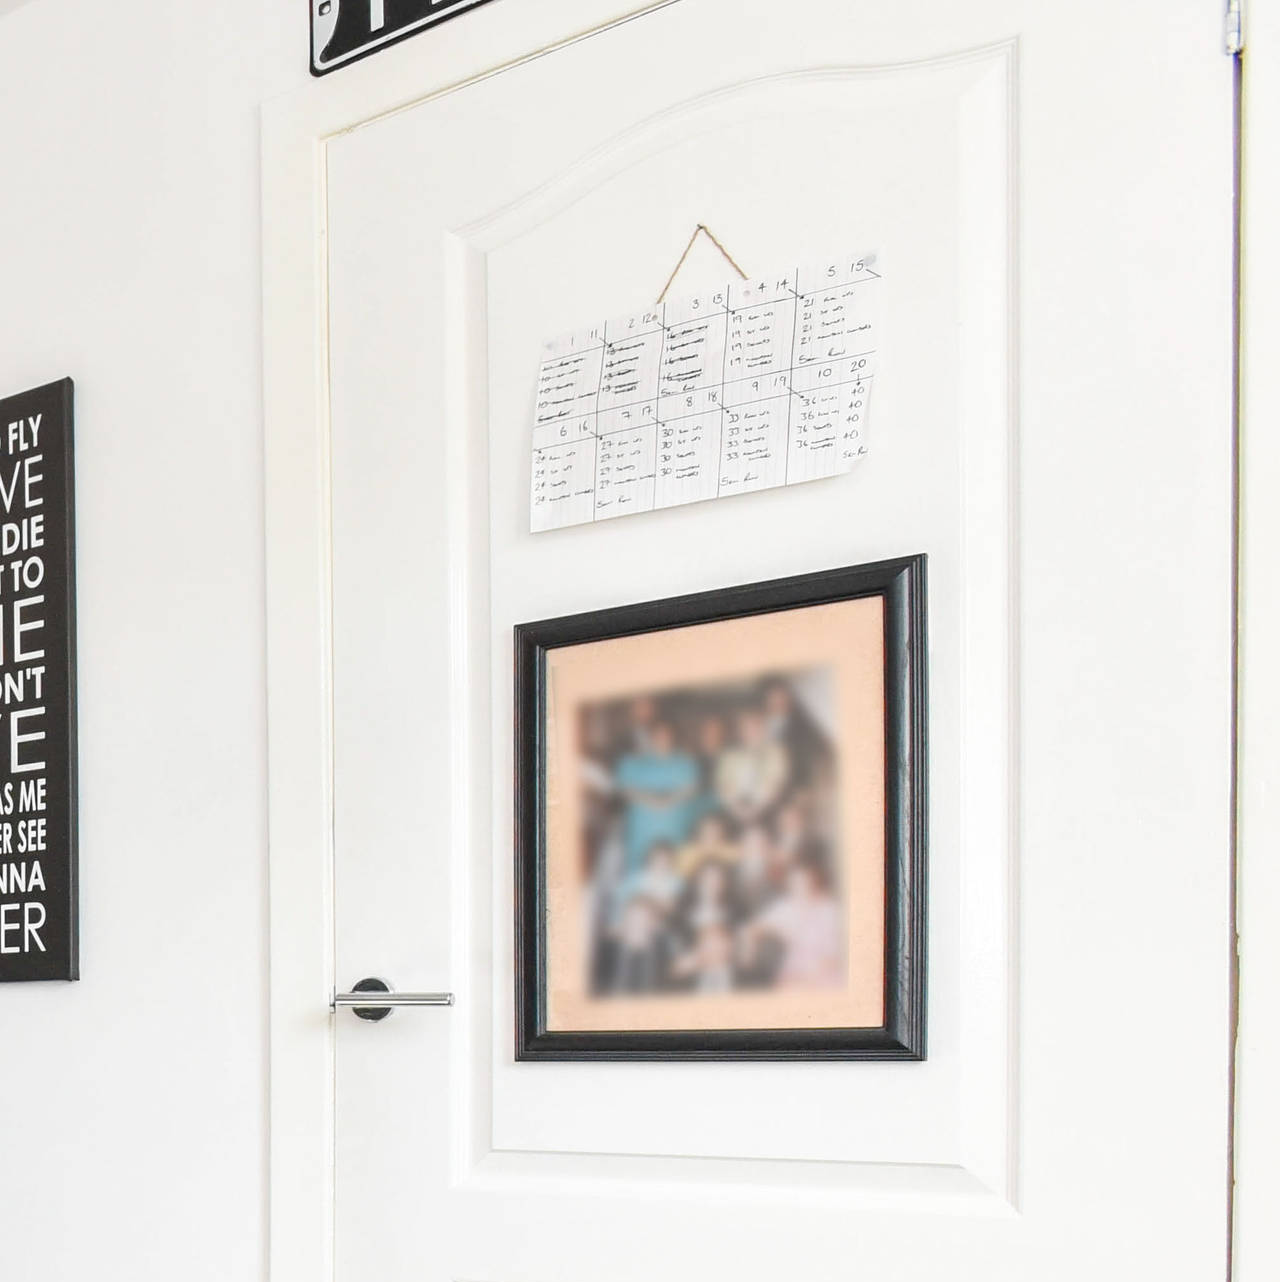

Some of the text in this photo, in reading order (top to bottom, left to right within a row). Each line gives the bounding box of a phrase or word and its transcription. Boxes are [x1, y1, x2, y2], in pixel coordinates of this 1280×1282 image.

[827, 259, 864, 277] 5 15
[758, 279, 788, 293] 4 14
[692, 299, 699, 309] 3
[818, 359, 866, 378] 10 20
[752, 376, 786, 391] 9 19
[707, 391, 717, 401] 18
[8, 413, 42, 455] FLY
[560, 420, 588, 436] 6 16
[2, 514, 44, 556] DIE
[11, 556, 44, 592] TO
[19, 778, 46, 813] ME
[17, 818, 46, 853] SEE
